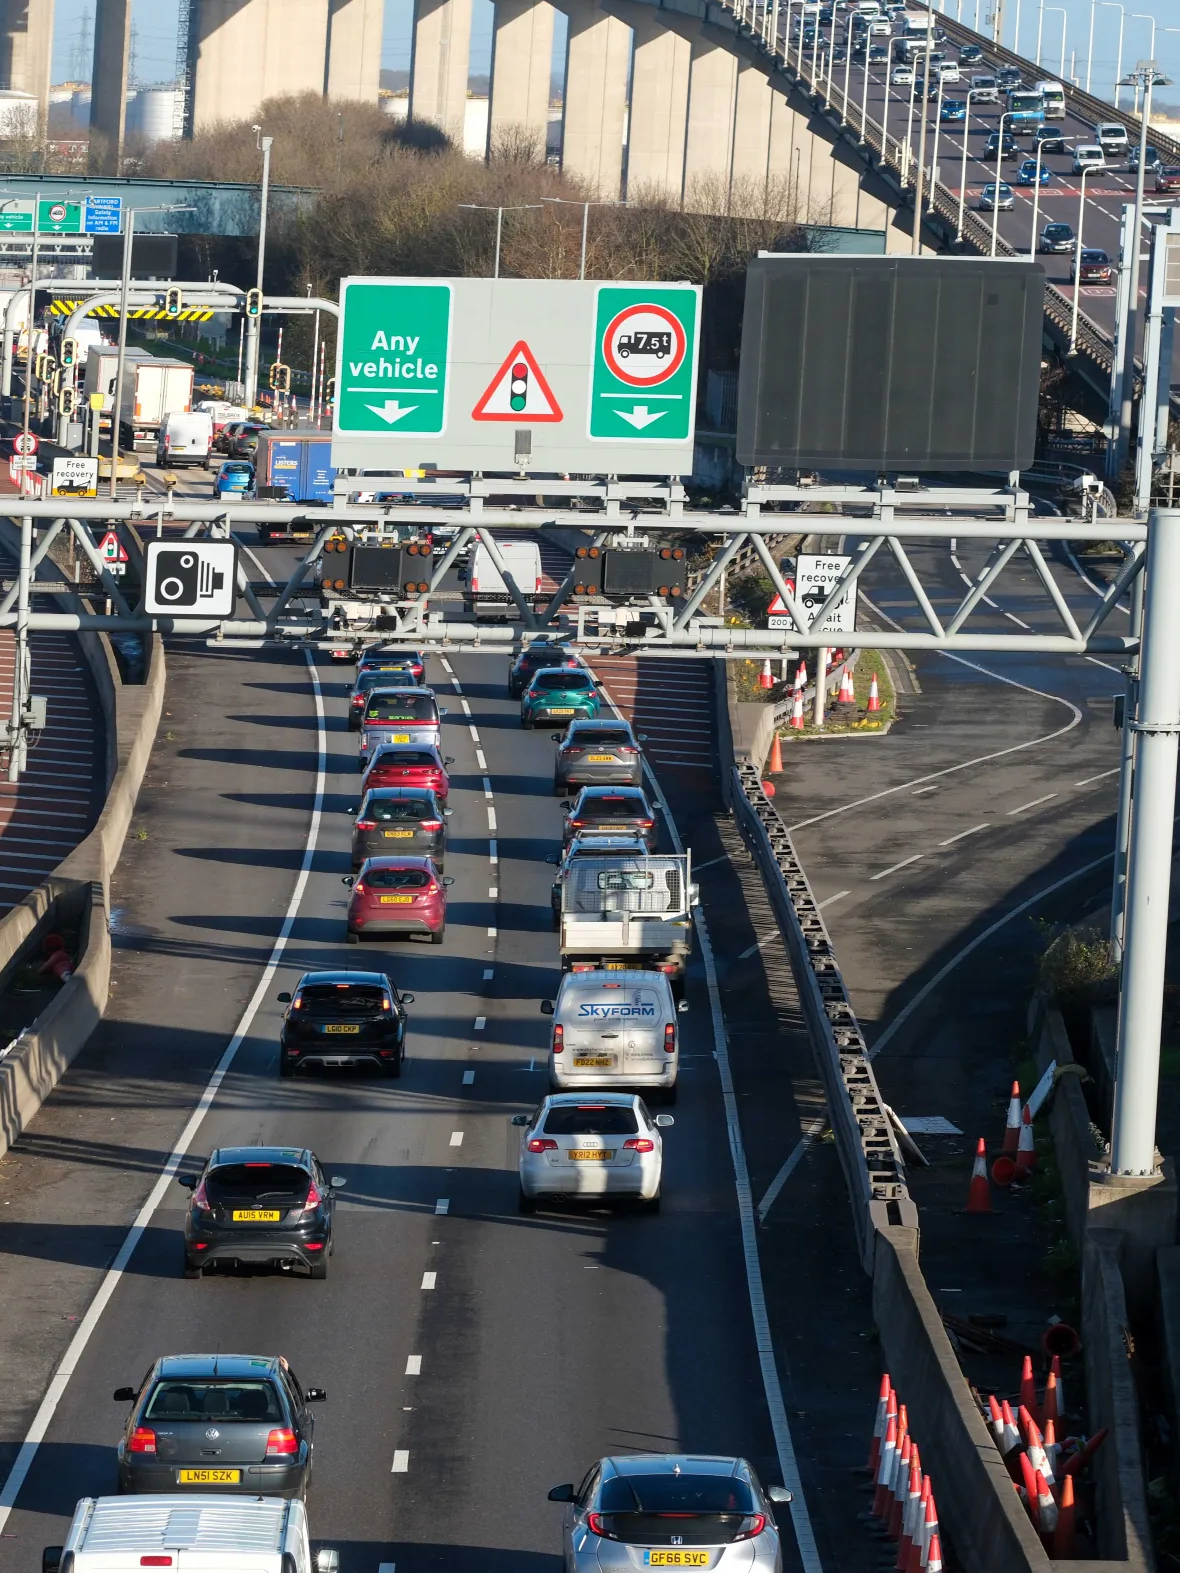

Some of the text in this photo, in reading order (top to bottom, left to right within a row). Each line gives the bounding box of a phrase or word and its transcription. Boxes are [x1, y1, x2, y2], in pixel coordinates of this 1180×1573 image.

[371, 330, 420, 354] Any
[348, 358, 438, 380] vehicle
[815, 560, 840, 570] Free
[808, 612, 841, 622] Aait
[187, 1471, 232, 1480] LN51 SZK
[652, 1553, 706, 1563] GF66 SVC
